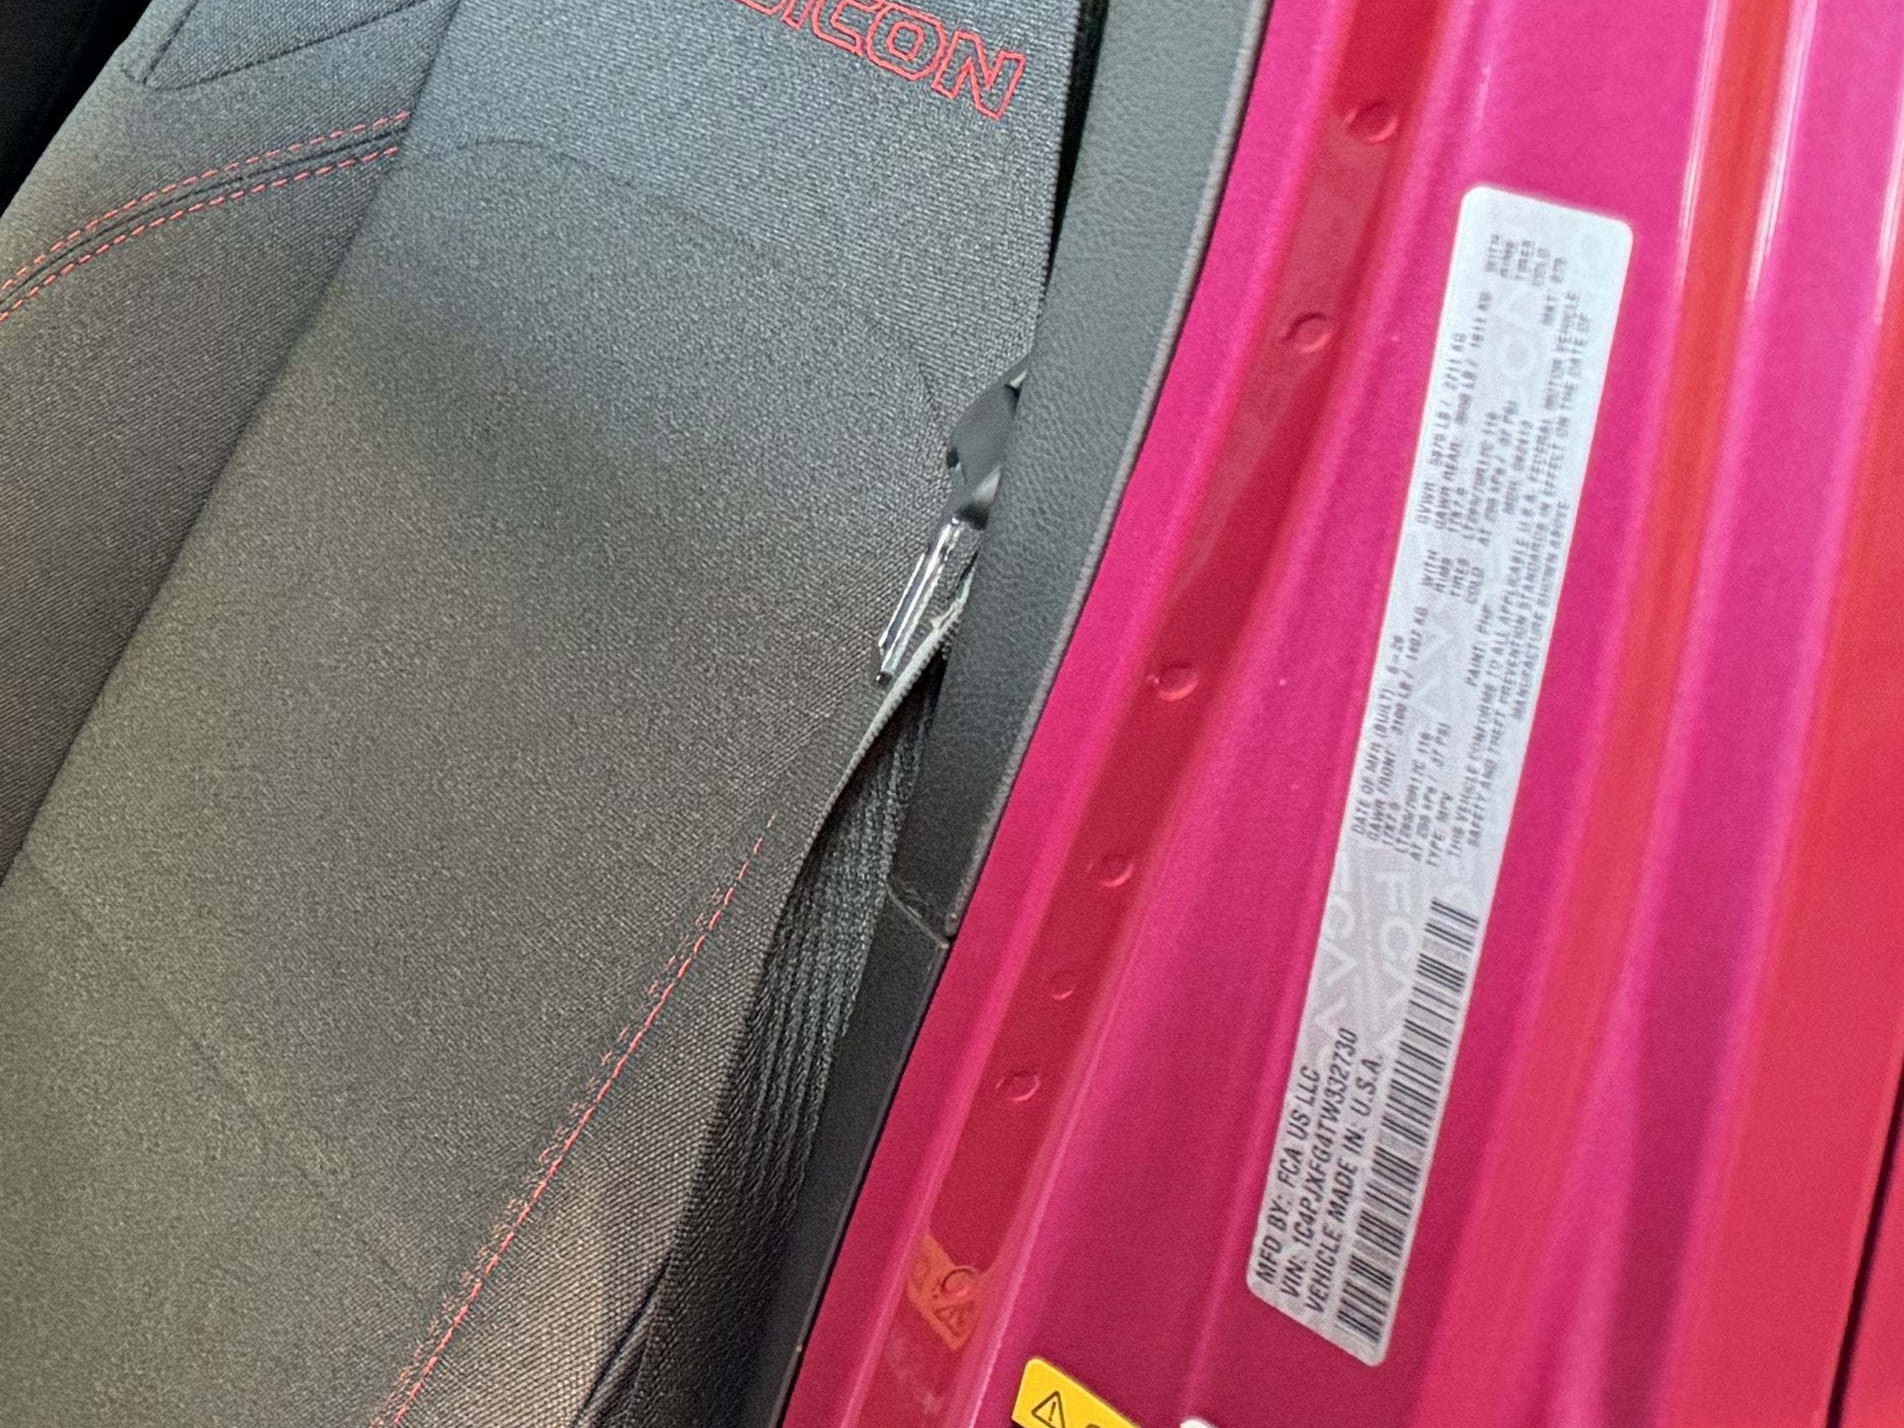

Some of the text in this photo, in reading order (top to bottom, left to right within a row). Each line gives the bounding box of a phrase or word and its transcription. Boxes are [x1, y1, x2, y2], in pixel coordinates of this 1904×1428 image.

[1359, 774, 1376, 796] OF
[1351, 797, 1371, 836] DATE
[1255, 1061, 1319, 1288] MFD BY: FCA US LLC
[1304, 1044, 1383, 1319] VEHICLE MADE IN: U.S.A.
[1280, 1249, 1311, 1304] VIN:
